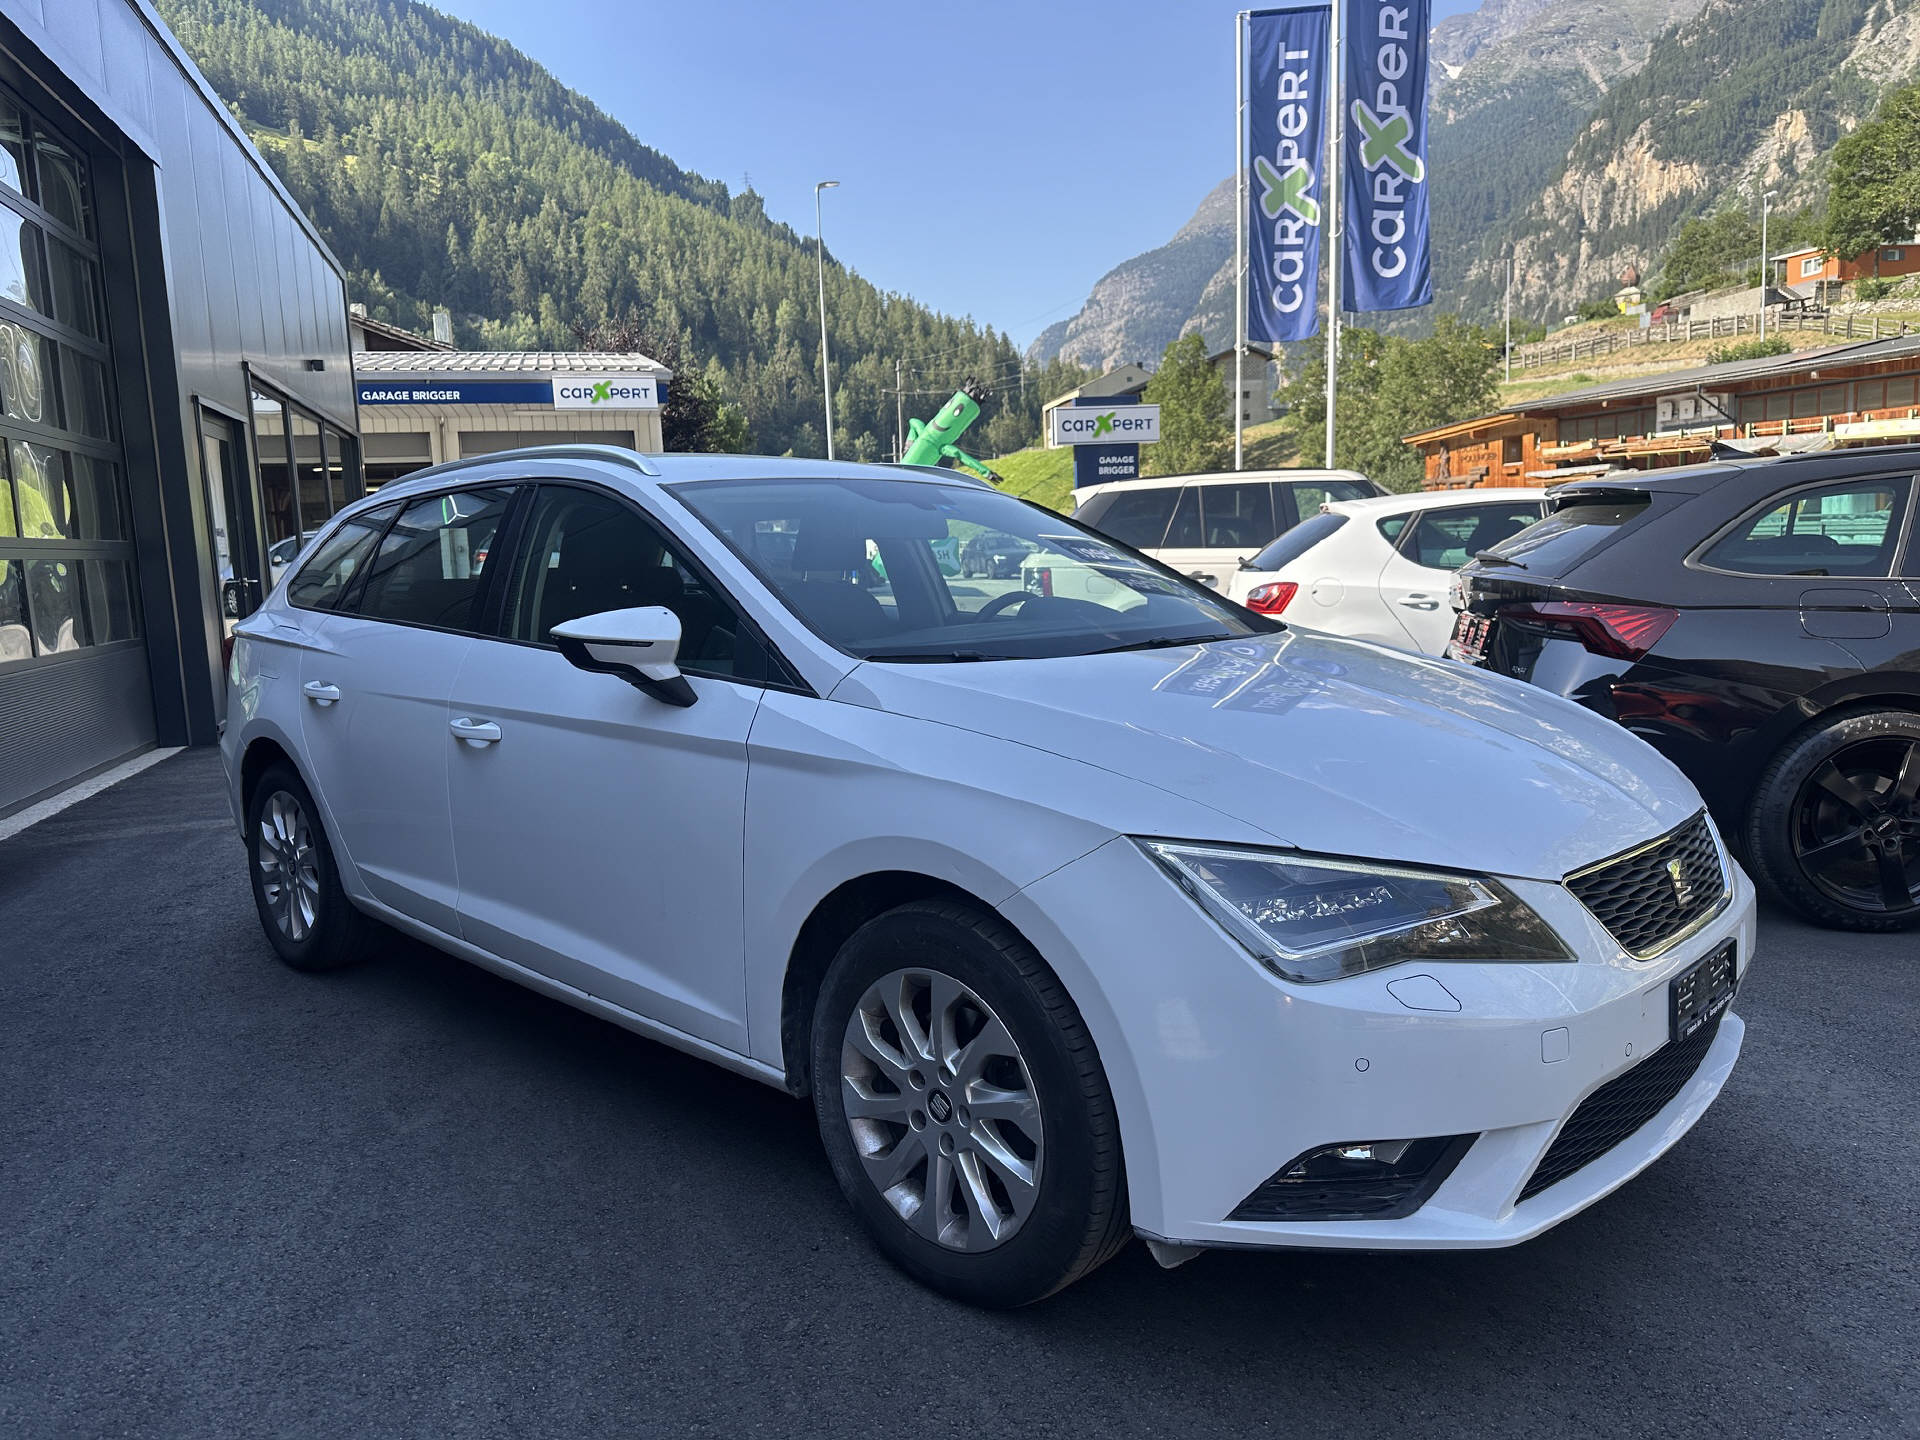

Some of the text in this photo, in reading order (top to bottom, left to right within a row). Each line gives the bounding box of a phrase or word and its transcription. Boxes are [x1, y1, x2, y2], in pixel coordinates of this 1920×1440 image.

[361, 389, 461, 401] GARAGE BRIGGER
[1098, 455, 1135, 464] GARAGE
[1098, 466, 1135, 475] BRIGGER
